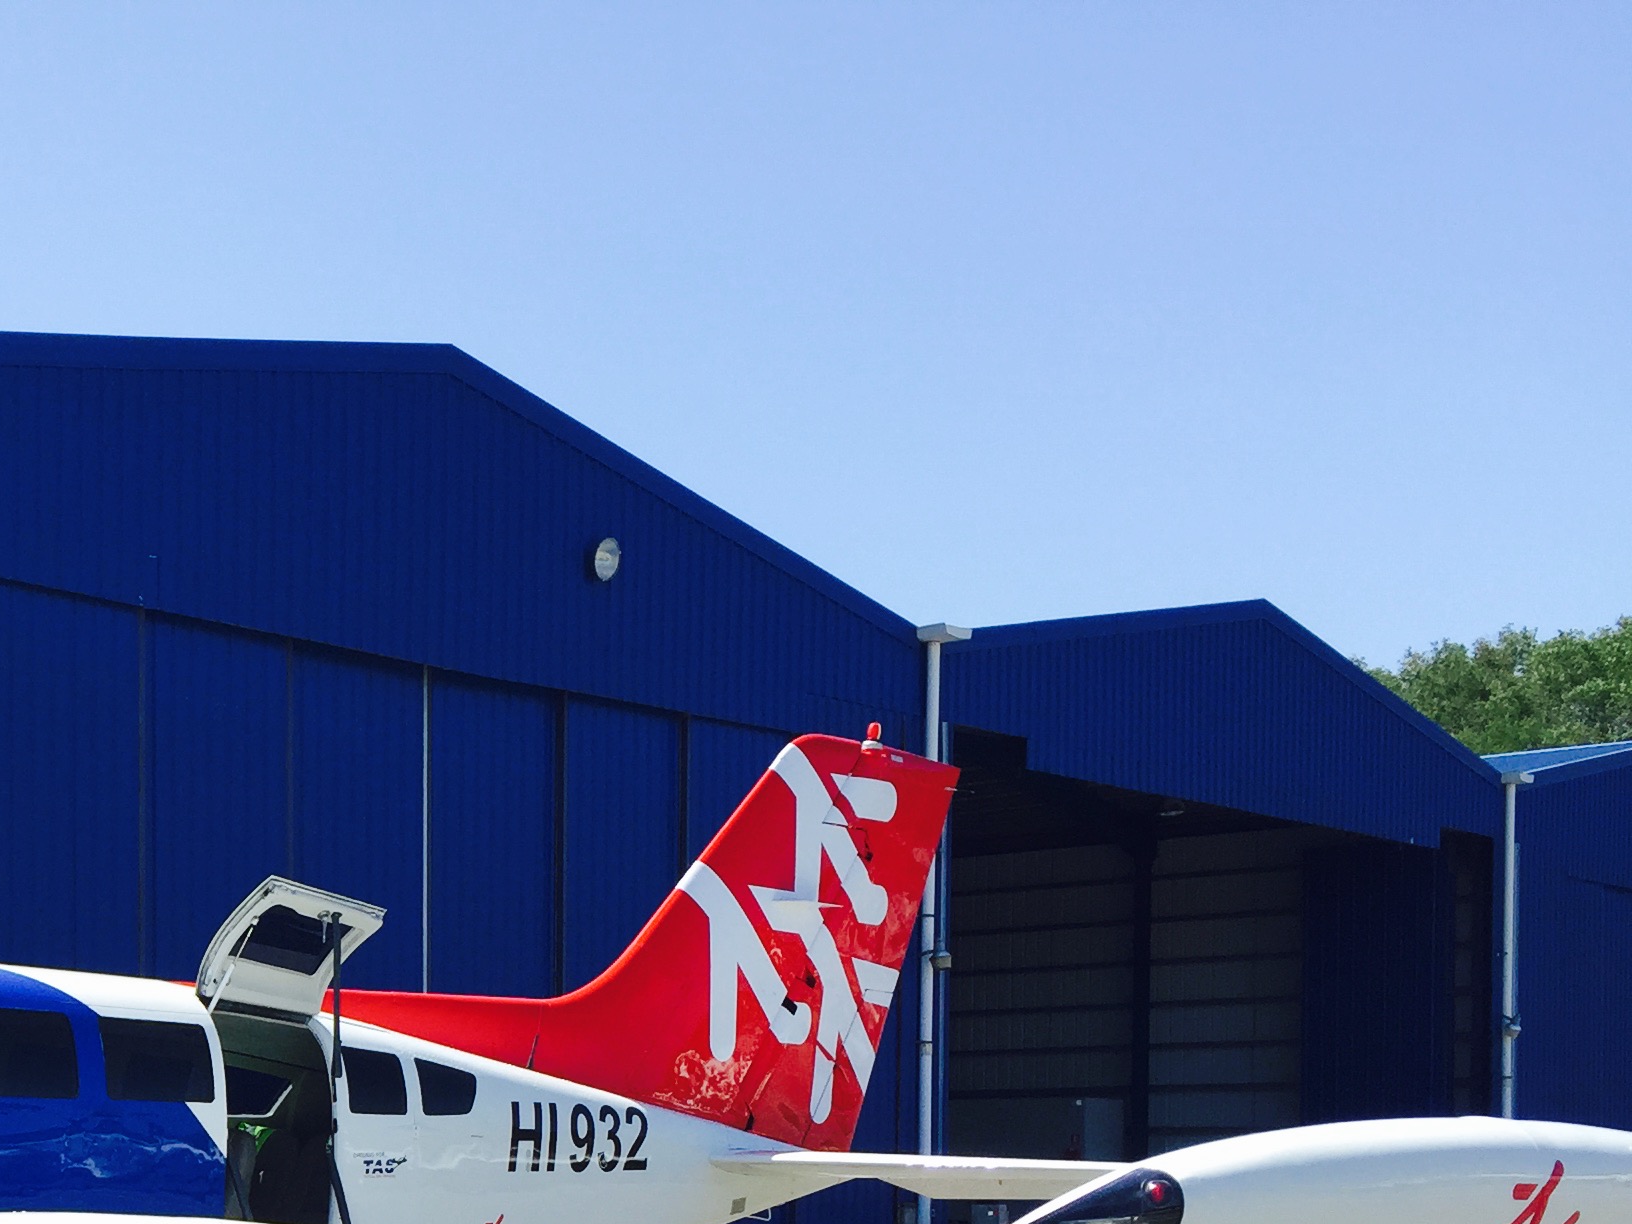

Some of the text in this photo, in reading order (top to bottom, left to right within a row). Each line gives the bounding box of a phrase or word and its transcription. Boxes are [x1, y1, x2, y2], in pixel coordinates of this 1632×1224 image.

[508, 1101, 648, 1173] HI 932
[363, 1158, 396, 1174] TAS
